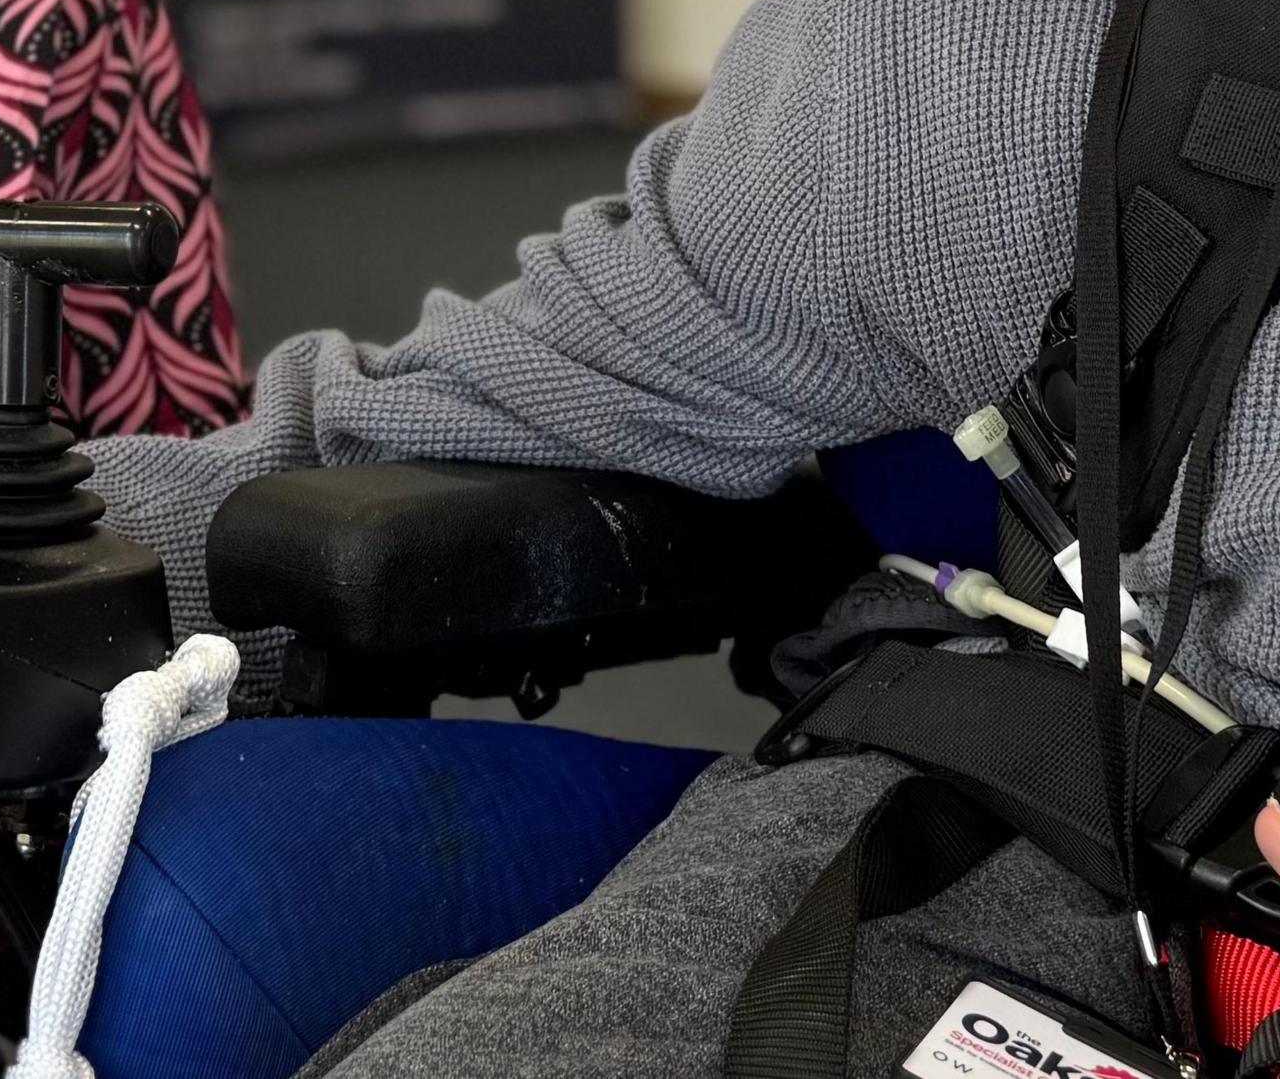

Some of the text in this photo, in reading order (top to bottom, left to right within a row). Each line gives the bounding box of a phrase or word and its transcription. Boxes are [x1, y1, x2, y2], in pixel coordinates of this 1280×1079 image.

[978, 413, 999, 435] FEED
[984, 421, 1006, 444] MED
[962, 1013, 1094, 1079] Oak
[1016, 1030, 1041, 1047] the
[950, 1030, 1034, 1078] Specialist
